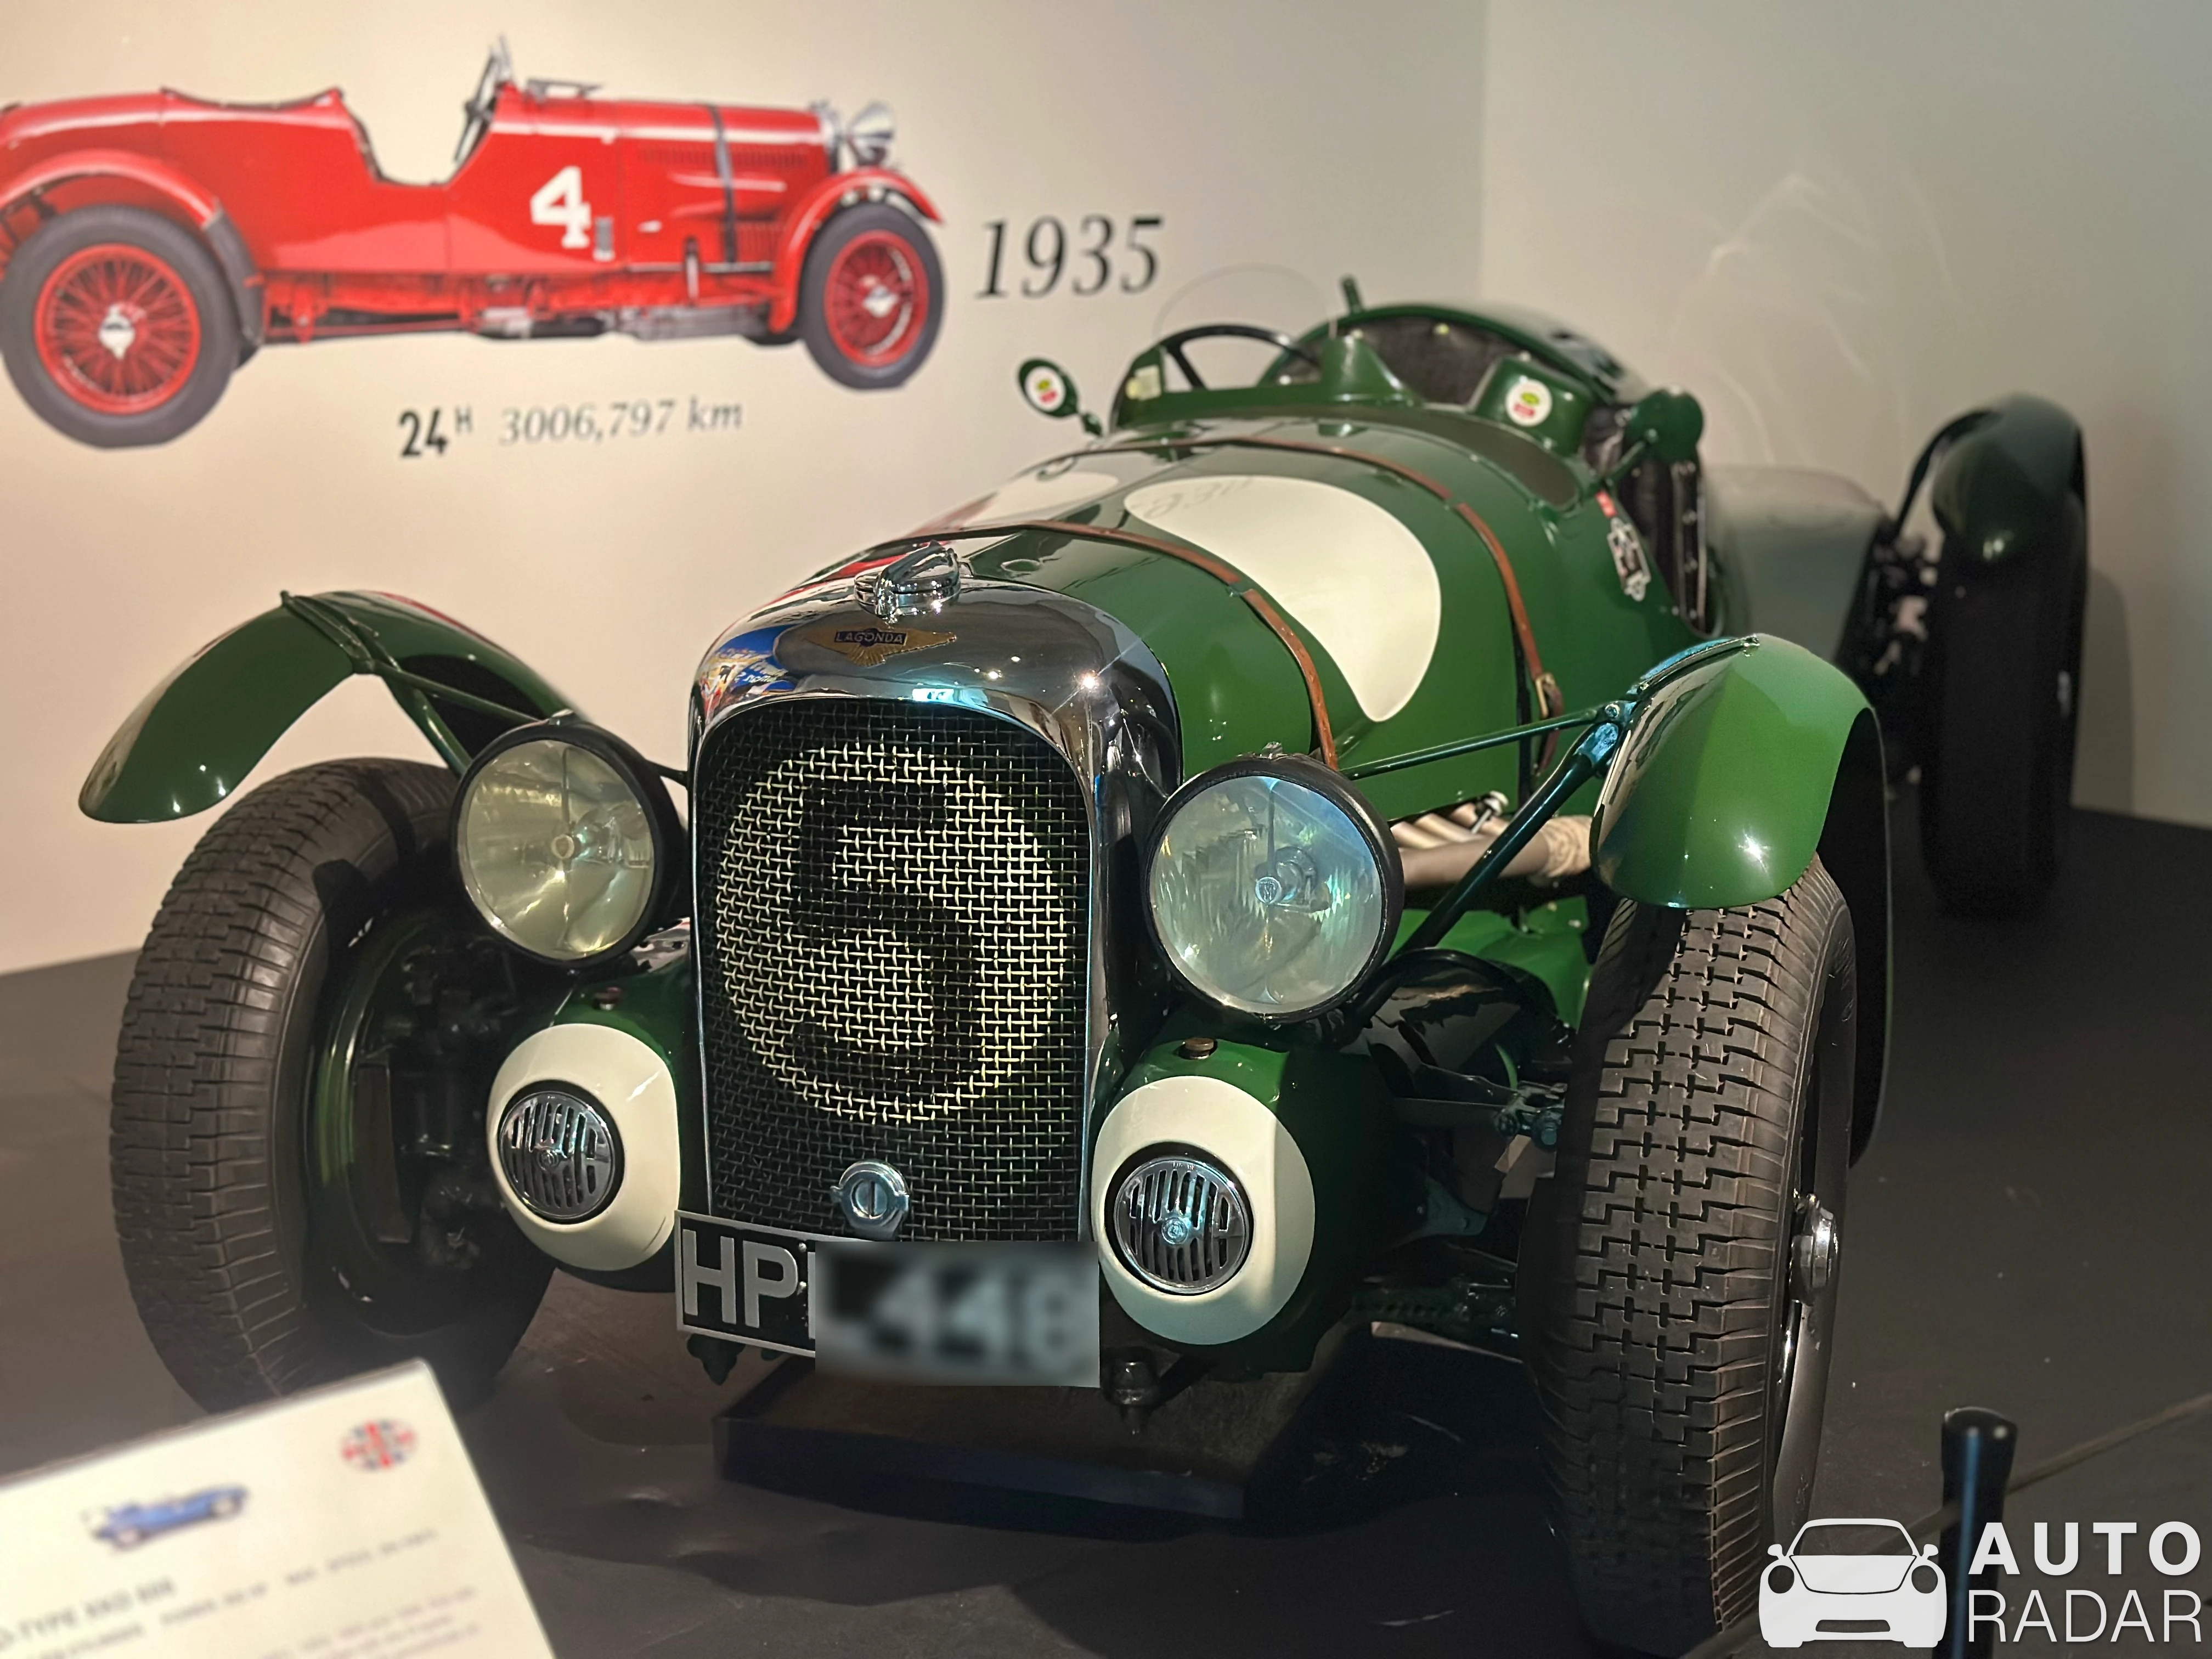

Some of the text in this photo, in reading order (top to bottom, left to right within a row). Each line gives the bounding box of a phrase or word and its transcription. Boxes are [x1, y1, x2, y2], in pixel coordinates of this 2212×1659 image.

[530, 166, 591, 249] 4
[974, 213, 1164, 298] 1935
[499, 399, 675, 445] 3006,797
[686, 395, 742, 431] km
[835, 631, 904, 644] LAGONDA
